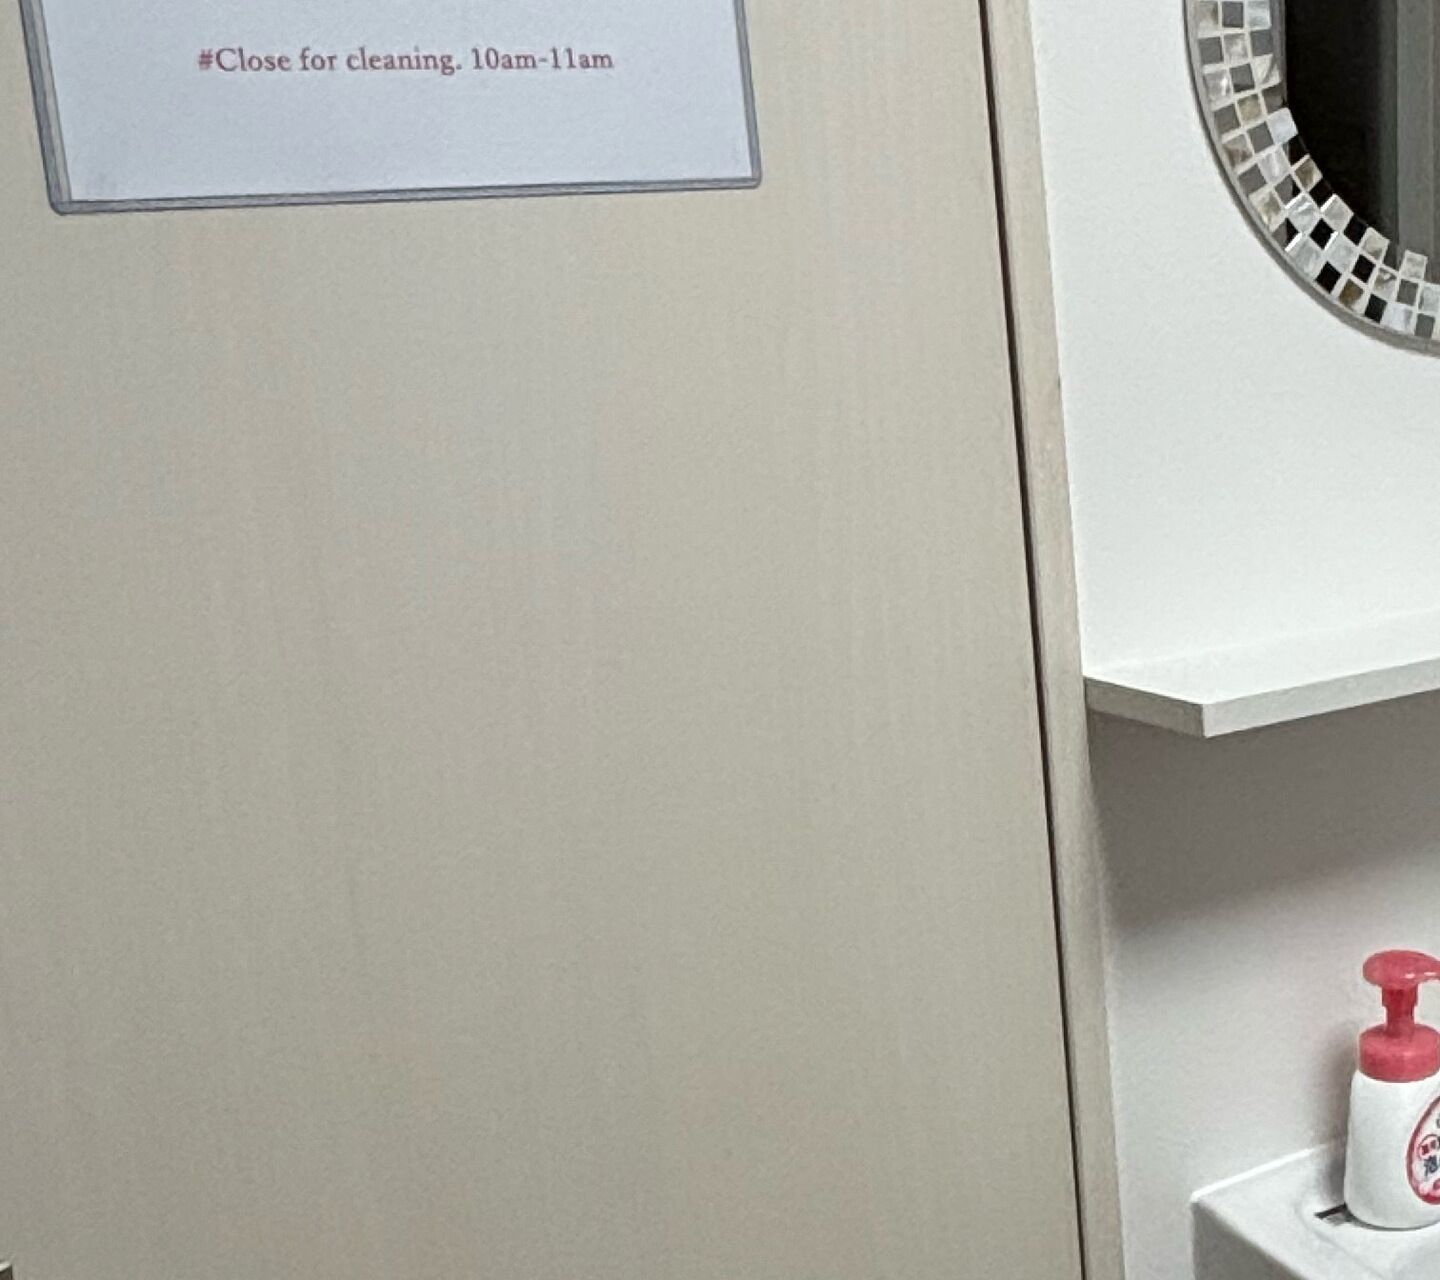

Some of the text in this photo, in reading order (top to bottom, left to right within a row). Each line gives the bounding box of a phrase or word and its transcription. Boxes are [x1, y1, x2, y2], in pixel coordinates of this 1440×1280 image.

[199, 46, 614, 76] #Close for cleaning. 10am-11am
